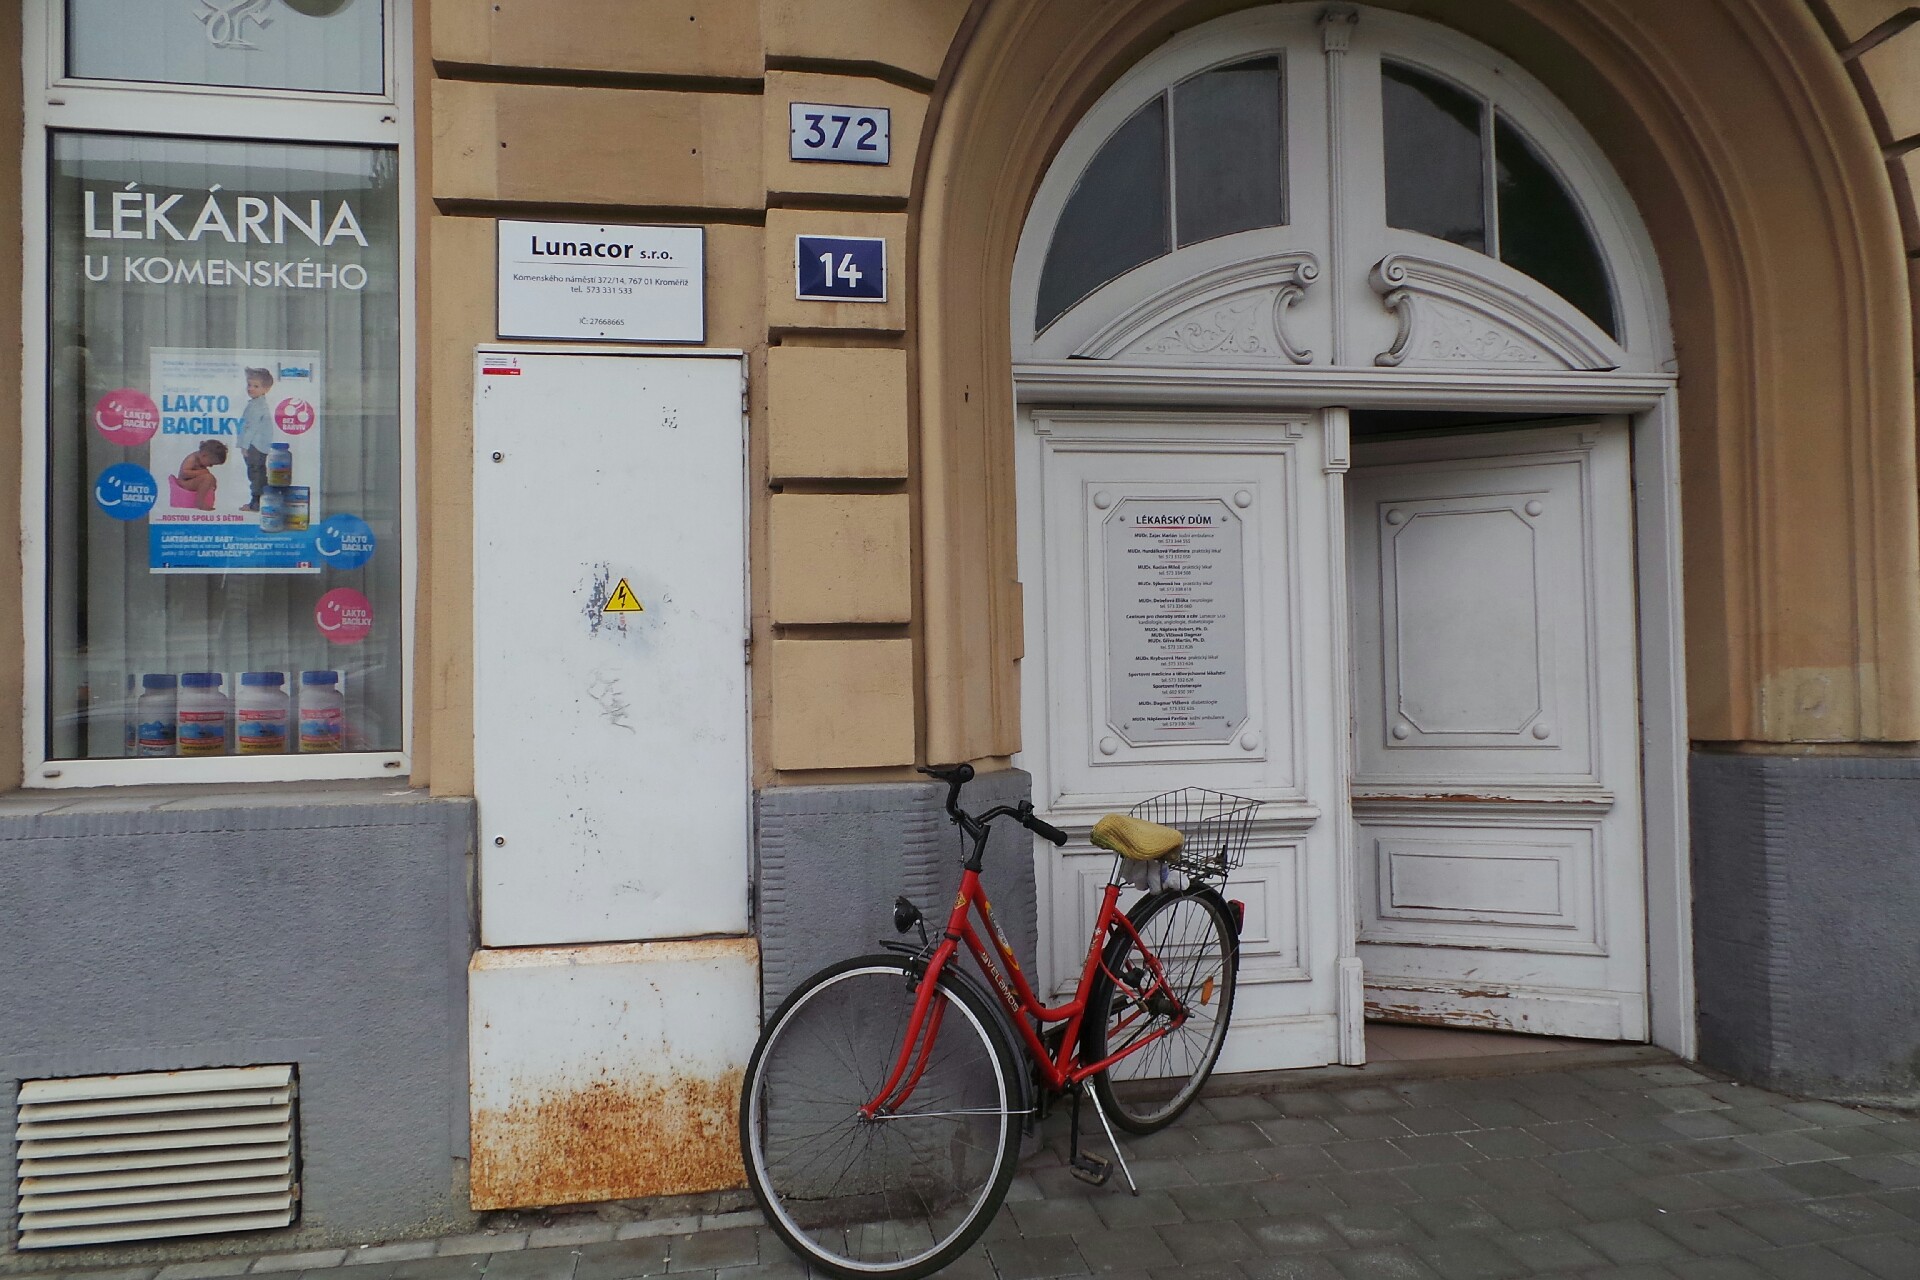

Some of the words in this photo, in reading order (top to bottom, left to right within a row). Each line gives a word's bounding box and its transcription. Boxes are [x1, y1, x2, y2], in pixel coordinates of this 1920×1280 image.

[804, 114, 878, 151] 372
[84, 181, 369, 247] LÉKÁRNA
[532, 235, 633, 258] Lunacor
[640, 250, 673, 260] s.r.o.
[84, 255, 109, 282] U
[125, 256, 369, 290] KOMENSKÉHO
[819, 252, 863, 288] 14
[513, 273, 564, 282] Komenského
[565, 275, 596, 283] náměstí
[655, 278, 689, 287] Kroměříž
[618, 287, 633, 295] 533
[163, 394, 229, 413] LAKTO
[124, 411, 151, 420] LAKTO
[162, 413, 245, 435] BACÍLKY
[123, 485, 149, 494] LAKTO
[192, 514, 215, 522] SPOLU
[216, 514, 221, 522] S
[223, 513, 244, 522] DĚTMI
[1136, 514, 1185, 524] LÉKAŘSKÝ
[1188, 514, 1211, 524] DŮM
[341, 535, 367, 544] LAKTO
[342, 609, 366, 617] LAKTO
